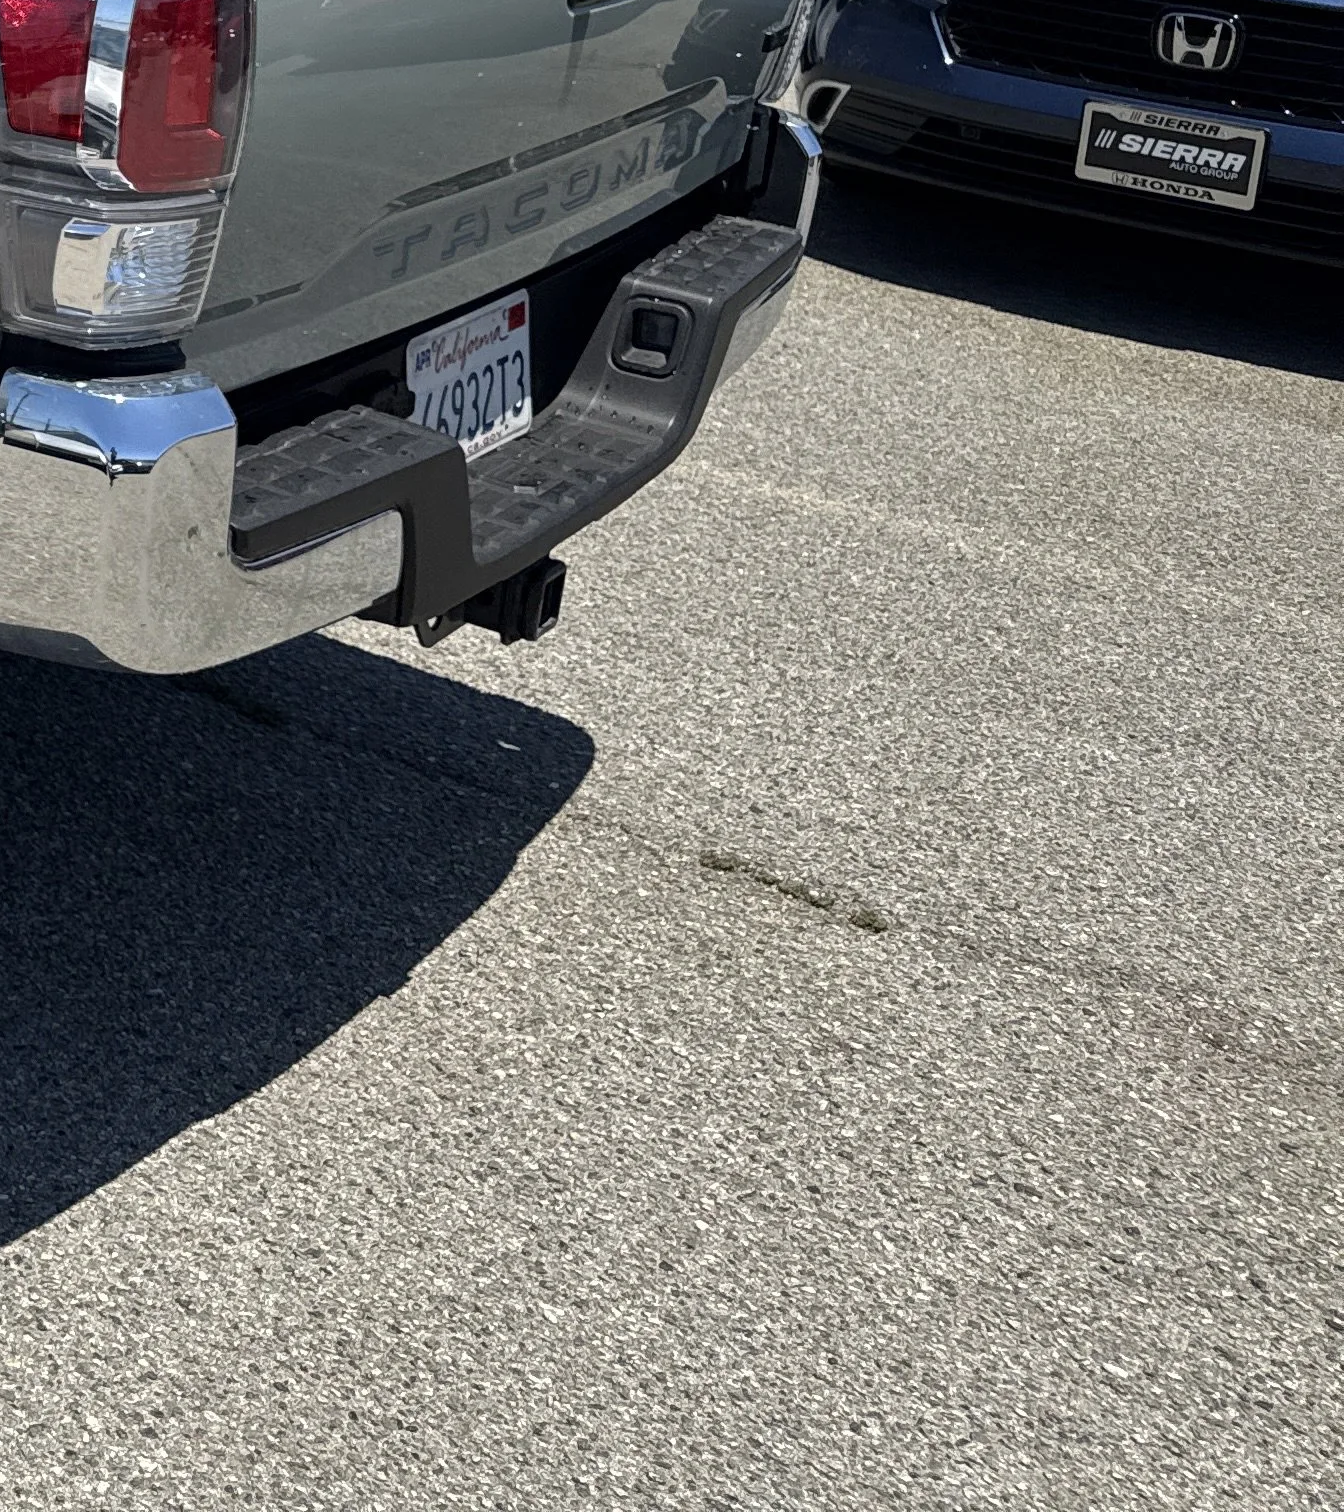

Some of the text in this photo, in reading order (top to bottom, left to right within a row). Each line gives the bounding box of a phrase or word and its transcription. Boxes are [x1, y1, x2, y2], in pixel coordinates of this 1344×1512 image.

[1143, 113, 1221, 137] SIERRA
[1118, 133, 1247, 173] SIERRA
[1169, 160, 1239, 182] AUTO GROUP
[373, 112, 700, 279] TACOMA
[1130, 177, 1216, 202] HONDA
[414, 326, 510, 374] APR California
